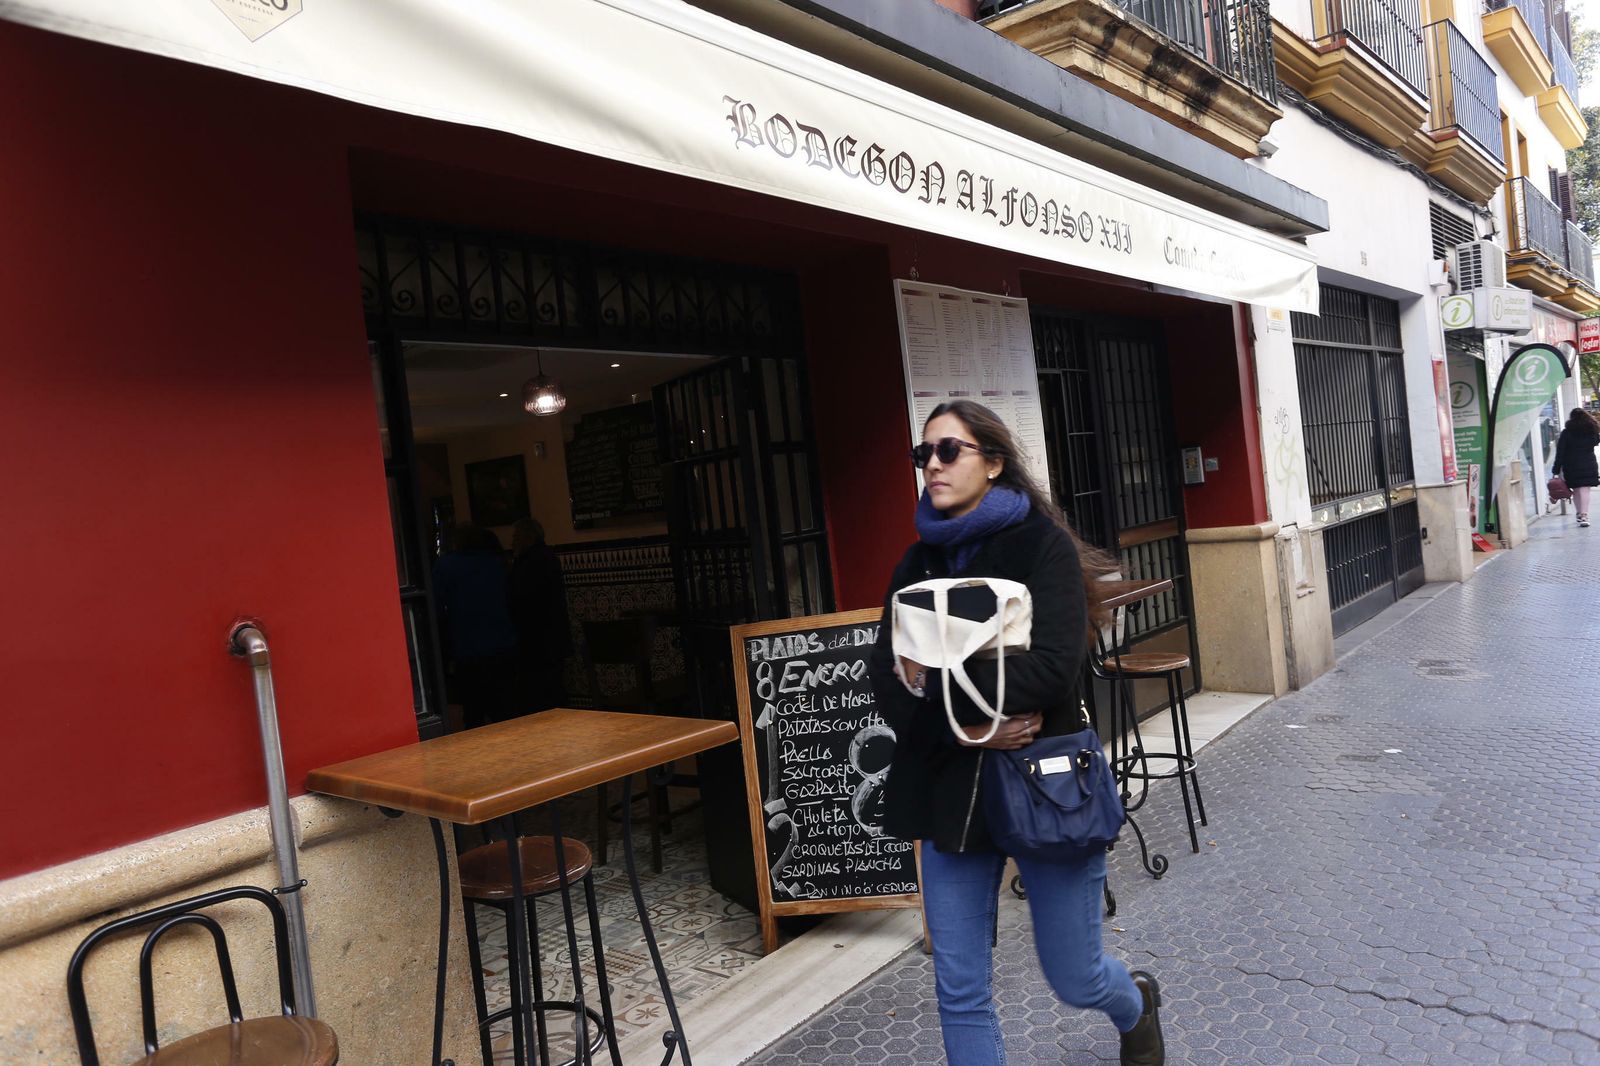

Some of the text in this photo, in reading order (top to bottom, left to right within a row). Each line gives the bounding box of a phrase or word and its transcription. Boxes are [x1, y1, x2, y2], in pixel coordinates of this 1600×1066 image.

[722, 94, 1133, 255] BODEGON ALFONSO XII
[749, 631, 826, 662] PLATOS
[822, 695, 840, 712] DE
[781, 860, 841, 879] SARDINAS
